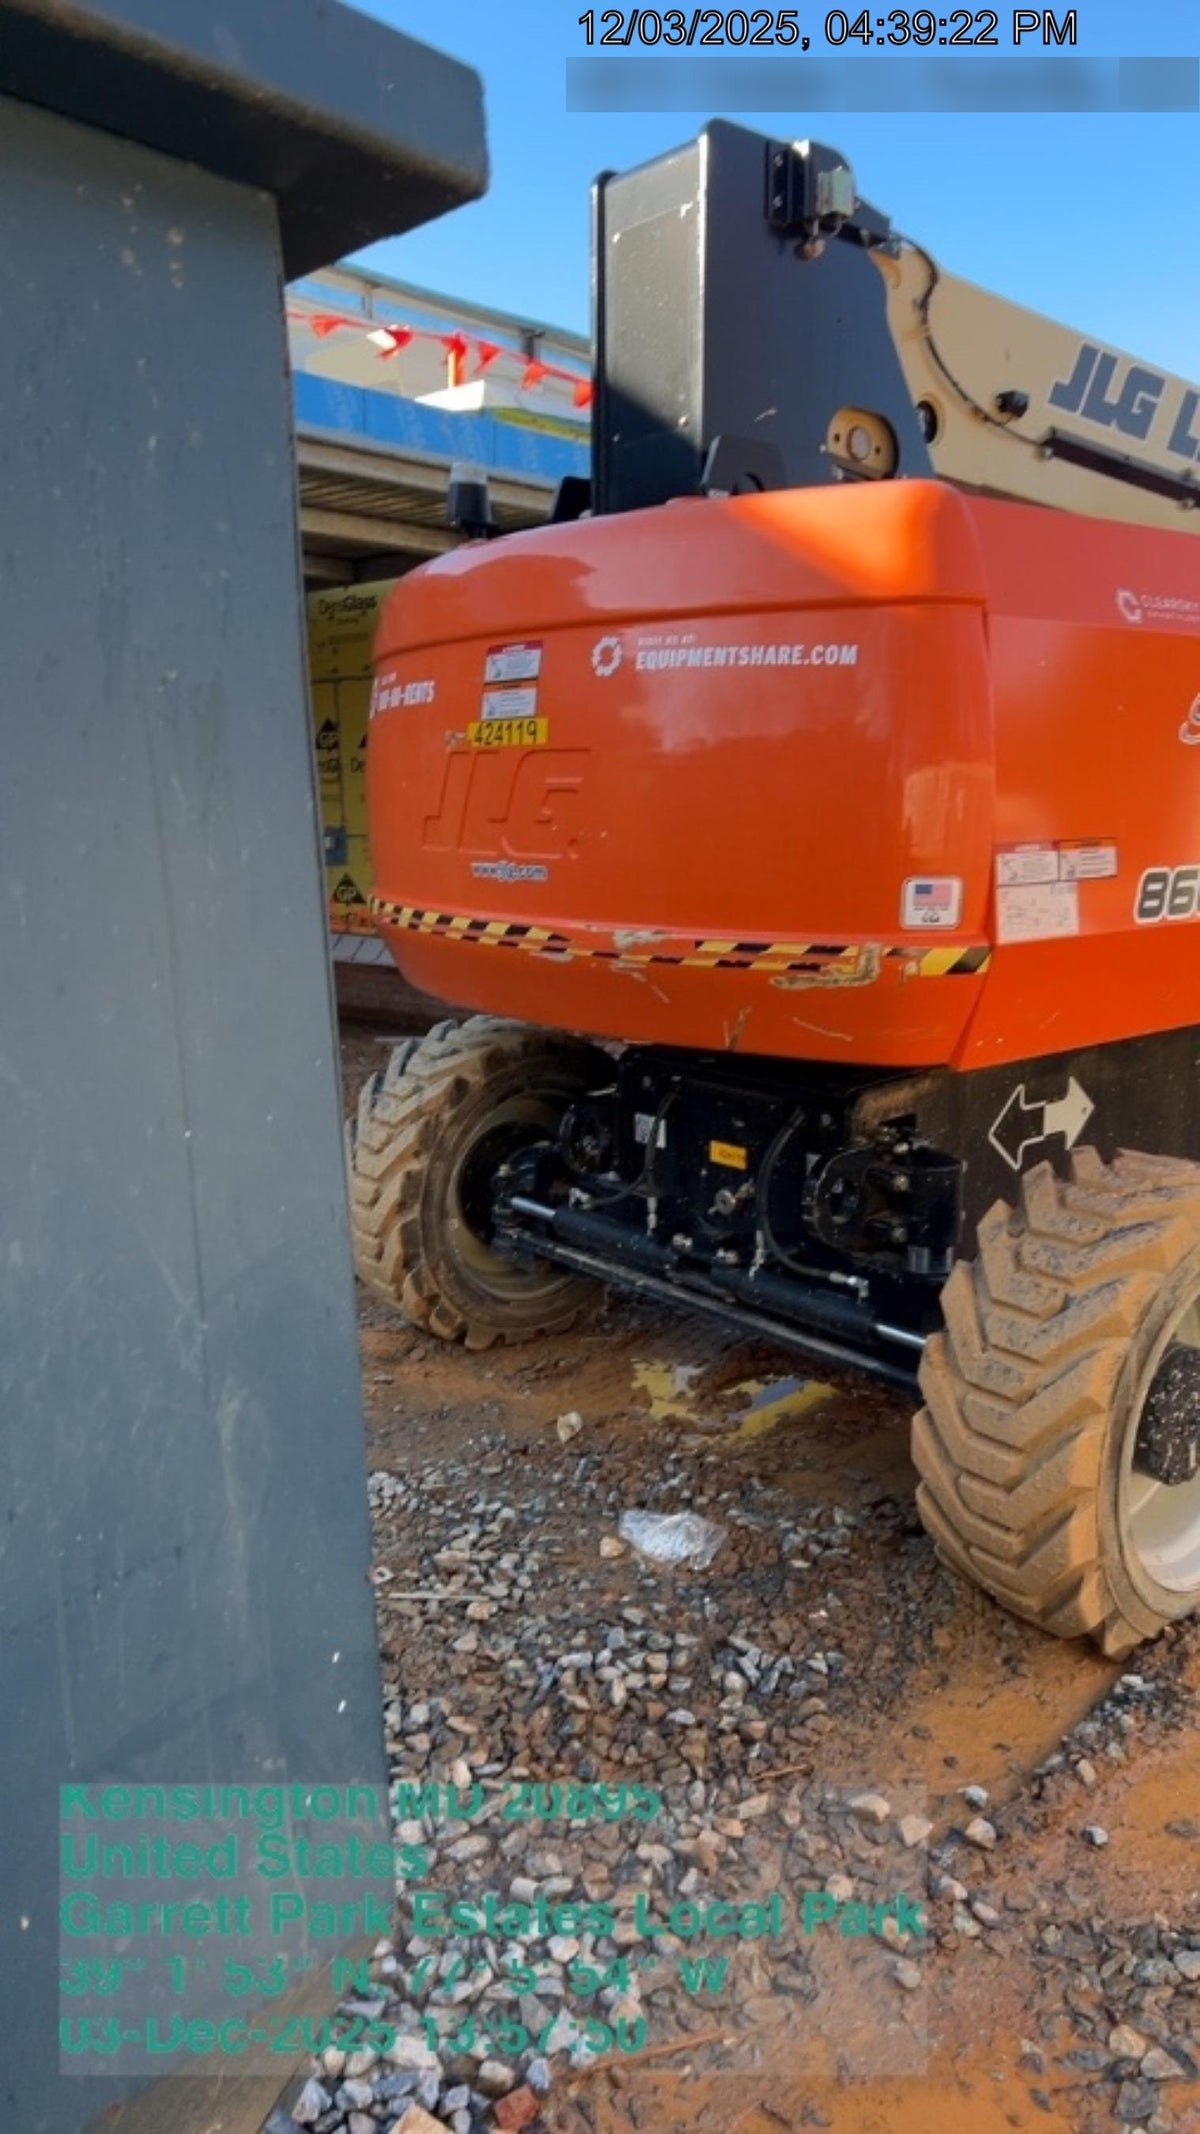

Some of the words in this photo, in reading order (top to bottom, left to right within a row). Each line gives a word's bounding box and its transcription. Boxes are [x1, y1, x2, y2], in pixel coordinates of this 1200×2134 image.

[1049, 342, 1165, 440] JLG
[1166, 388, 1200, 462] L
[636, 645, 858, 670] EQUIPMENTSHARE.COM
[474, 719, 537, 745] 424119
[421, 747, 592, 860] JLG
[1134, 865, 1200, 925] 86
